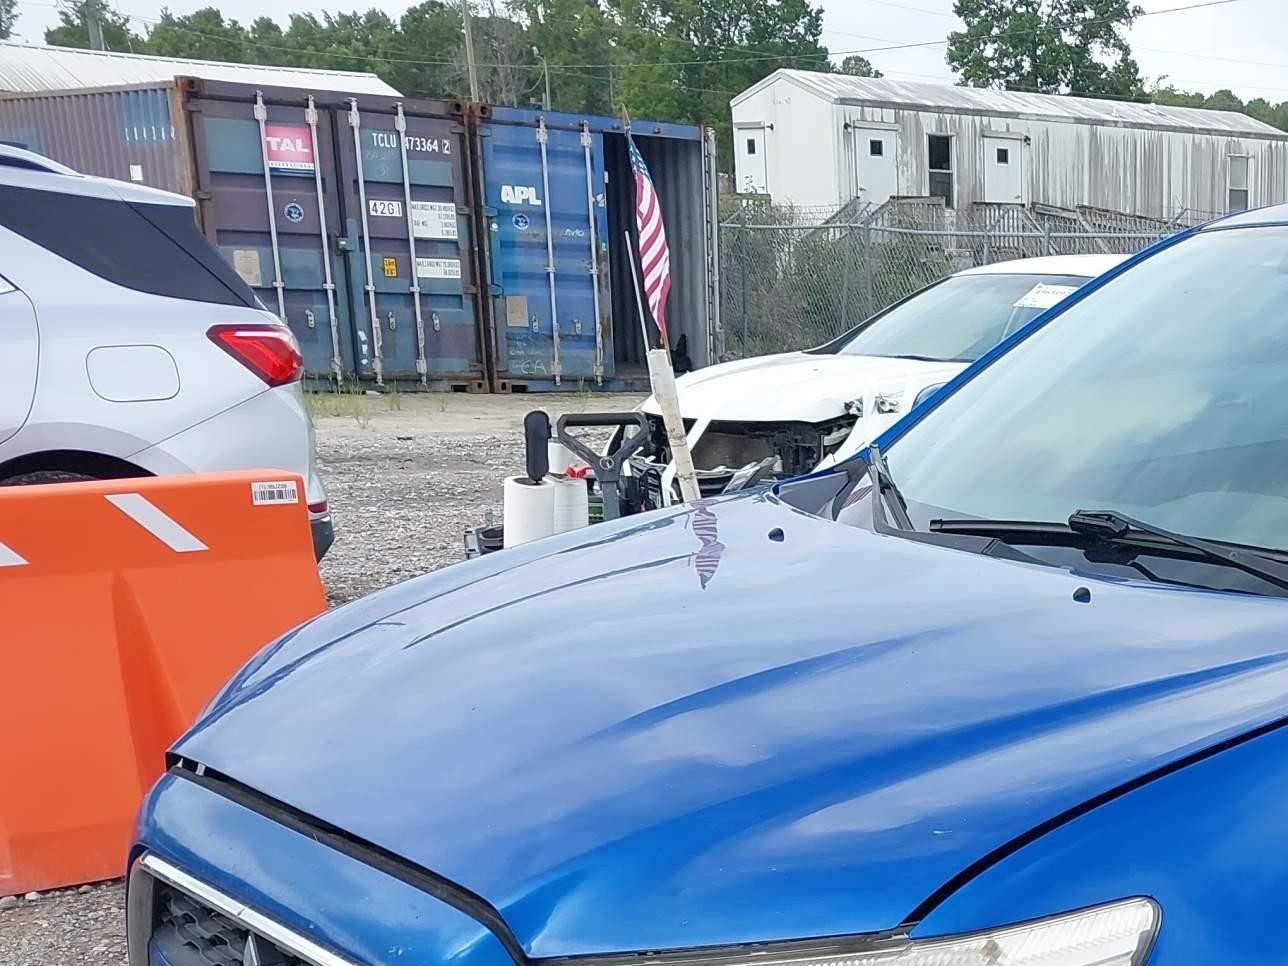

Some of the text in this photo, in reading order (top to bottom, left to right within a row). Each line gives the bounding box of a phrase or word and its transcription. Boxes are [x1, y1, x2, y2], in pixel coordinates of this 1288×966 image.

[266, 136, 310, 153] TAL
[371, 132, 397, 148] TCLU
[443, 139, 451, 154] 2
[501, 184, 542, 206] APL
[371, 202, 401, 215] 42G1
